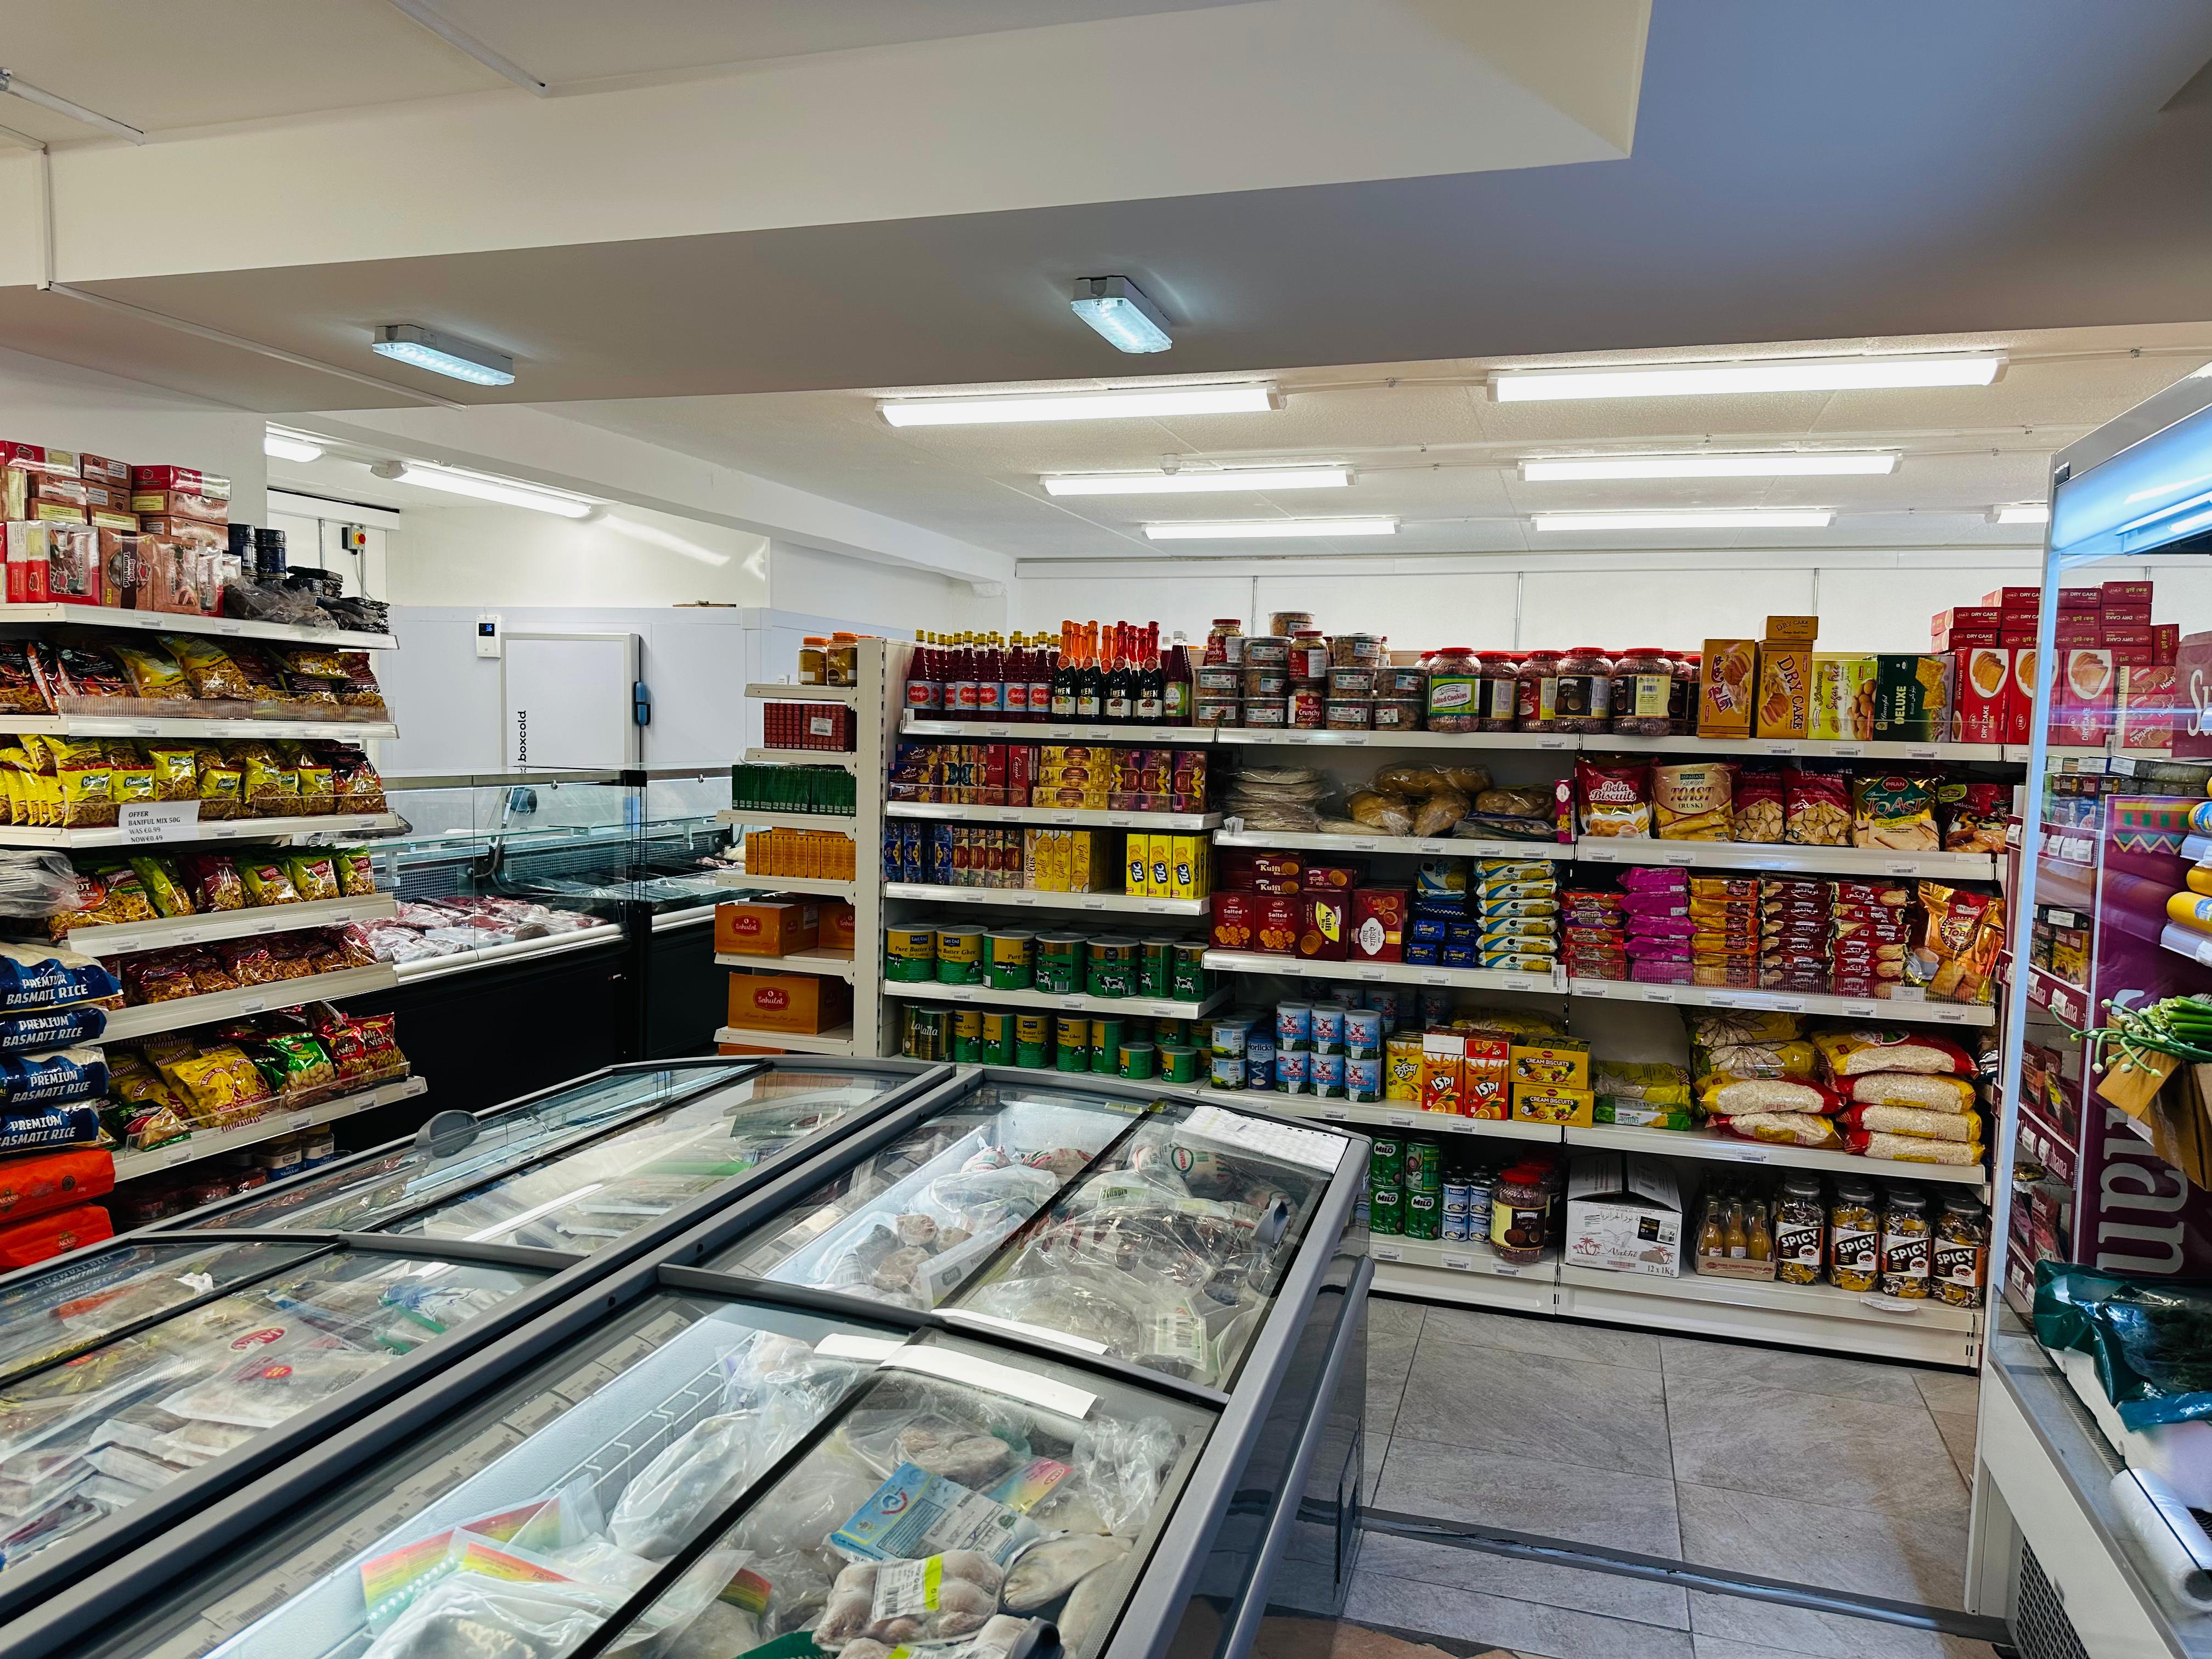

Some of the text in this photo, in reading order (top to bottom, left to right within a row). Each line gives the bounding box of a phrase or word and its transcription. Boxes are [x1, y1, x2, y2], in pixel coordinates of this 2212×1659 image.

[1775, 620, 1791, 631] DRY
[1777, 654, 1804, 730] DRY CAKE
[1825, 665, 1839, 710] Sugar Free
[1433, 692, 1468, 704] Salted Cookies
[1894, 686, 1906, 725] DELUXE
[1299, 709, 1320, 717] Crunchy
[518, 710, 527, 762] boxcold
[1602, 781, 1629, 792] Bela
[1669, 786, 1714, 802] TOAST
[1589, 789, 1637, 802] Biscuits
[1866, 797, 1926, 815] TOAST
[1025, 856, 1036, 881] Plus
[1132, 863, 1144, 882] TUC
[1155, 864, 1167, 882] TUC
[1178, 865, 1191, 884] TUC
[1260, 864, 1281, 872] Kulfi
[1260, 883, 1281, 892] Kulfi
[736, 921, 757, 931] Sahulat
[1945, 927, 1974, 940] Toast
[22, 974, 67, 989] PREMIUM
[6, 984, 88, 1005] BASMATI RICE
[758, 995, 784, 1005] Sahulat
[19, 1015, 69, 1031] PREMIUM
[2, 1027, 83, 1047] BASMATI RICE
[363, 1030, 378, 1040] Mr.
[334, 1044, 358, 1056] Twist
[1247, 1042, 1273, 1051] Horlicks
[30, 1070, 78, 1087] PREMIUM
[201, 1071, 214, 1086] RING
[1431, 1076, 1454, 1092] ISPI
[11, 1081, 91, 1103] BASMATI RICE
[134, 1083, 147, 1097] RING
[1475, 1081, 1499, 1097] ISPI
[1550, 1097, 1573, 1105] BISCUITS
[10, 1115, 62, 1132] PREMIUM
[50, 1126, 75, 1139] RICE
[1375, 1145, 1394, 1154] MILO
[1378, 1194, 1396, 1202] MILO
[1413, 1199, 1432, 1207] MILO
[59, 1237, 77, 1247] AKASH
[1781, 1230, 1818, 1248] SPICY
[1838, 1235, 1875, 1255] SPICY
[1890, 1242, 1927, 1262] SPICY
[1936, 1250, 1974, 1265] SPICY
[1647, 1264, 1655, 1272] 12
